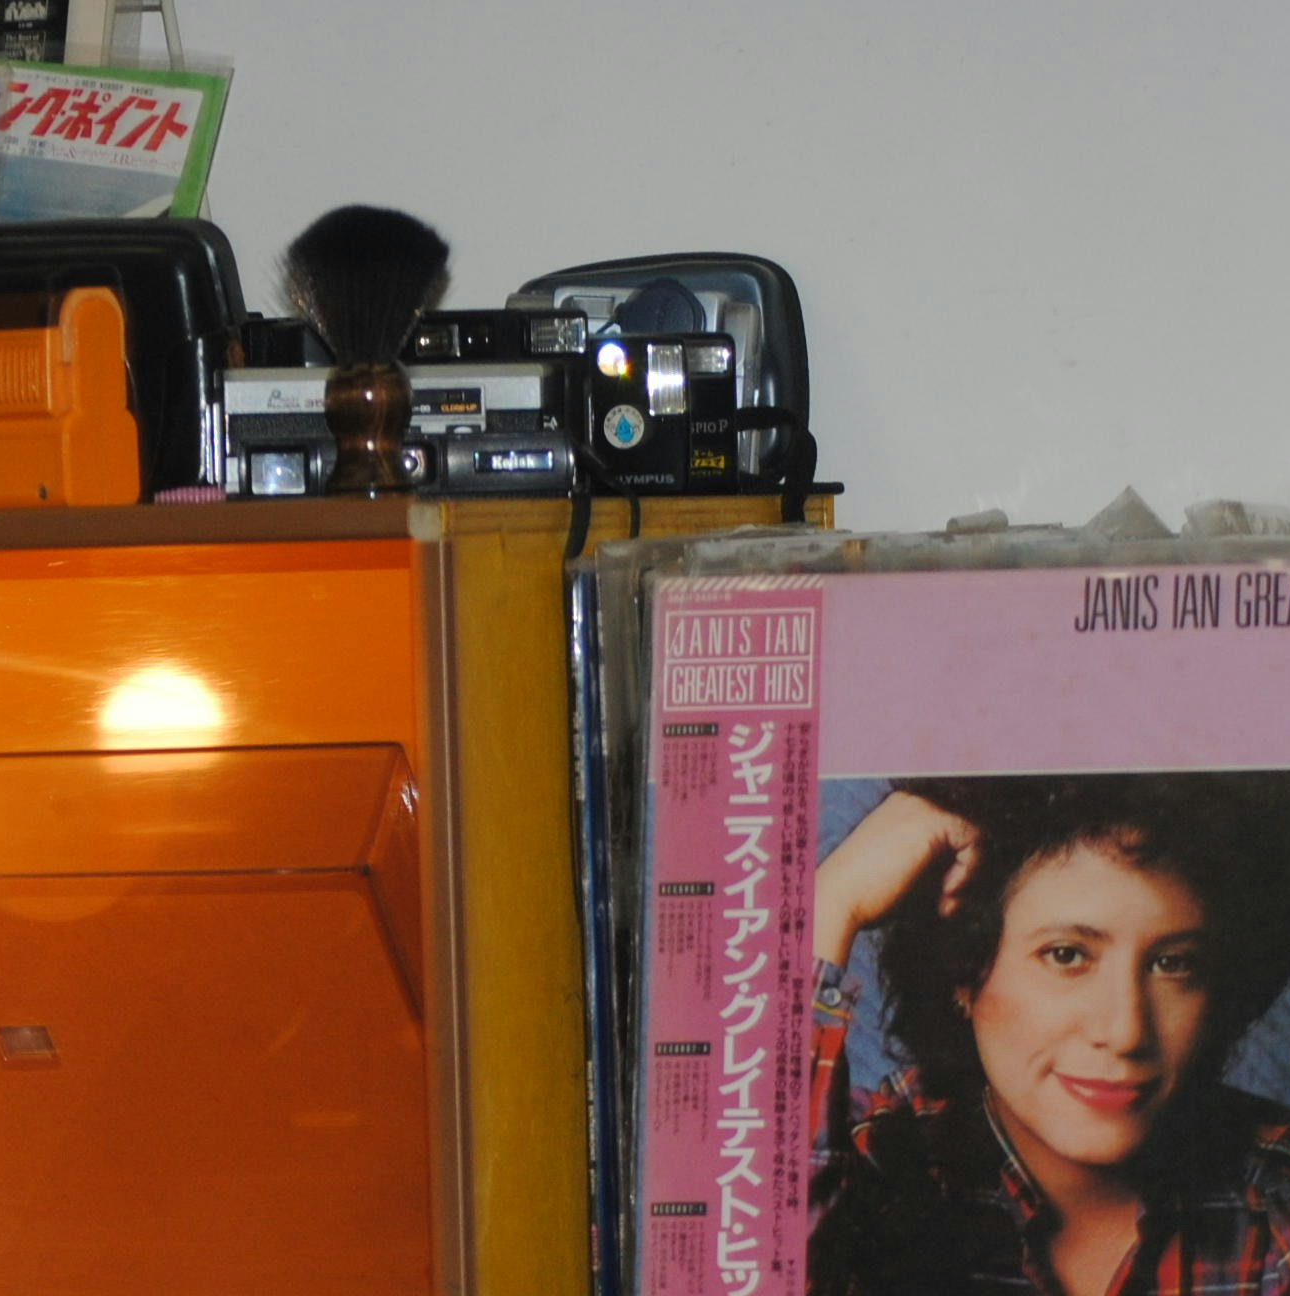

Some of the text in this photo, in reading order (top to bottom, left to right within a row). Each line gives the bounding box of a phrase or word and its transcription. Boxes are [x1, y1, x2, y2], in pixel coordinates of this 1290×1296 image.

[1075, 575, 1159, 632] JANIS
[1172, 573, 1220, 628] IAN
[672, 616, 807, 656] JANIS IAN
[672, 663, 804, 704] GREATEST HITS
